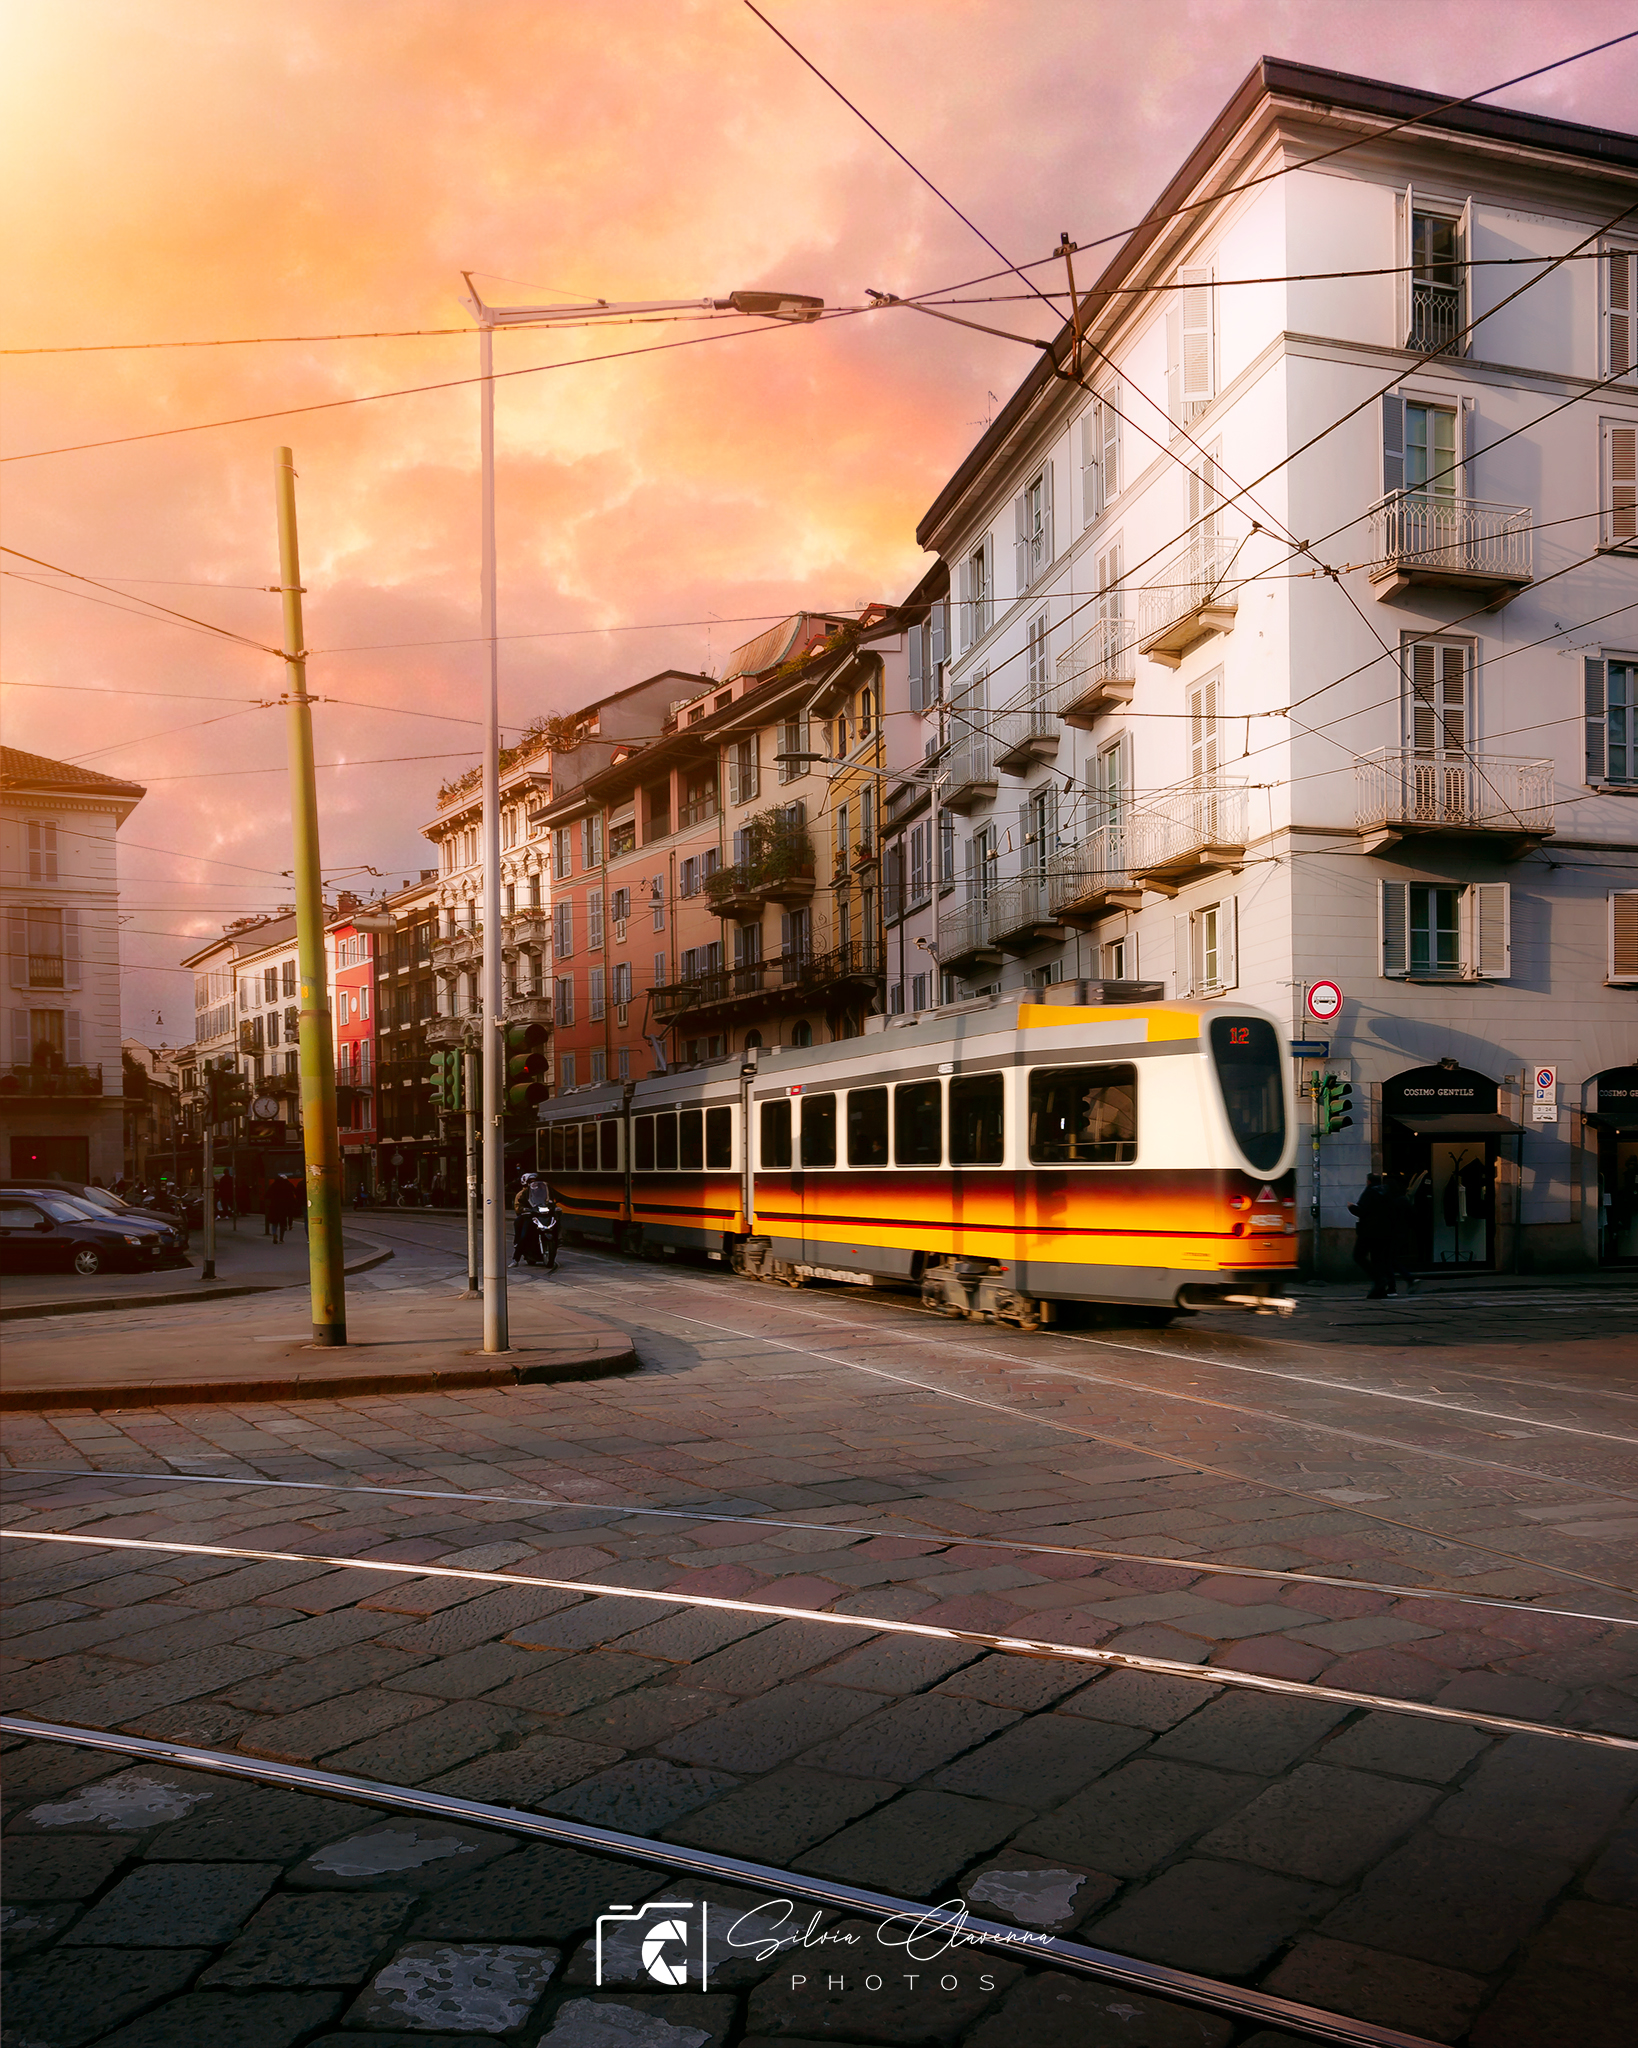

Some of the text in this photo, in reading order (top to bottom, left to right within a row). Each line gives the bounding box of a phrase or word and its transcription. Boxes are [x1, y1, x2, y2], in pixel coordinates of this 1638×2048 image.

[1229, 1027, 1249, 1044] 12
[1404, 1088, 1474, 1096] COSIMO GENTILE
[1599, 1089, 1628, 1097] COSIMO
